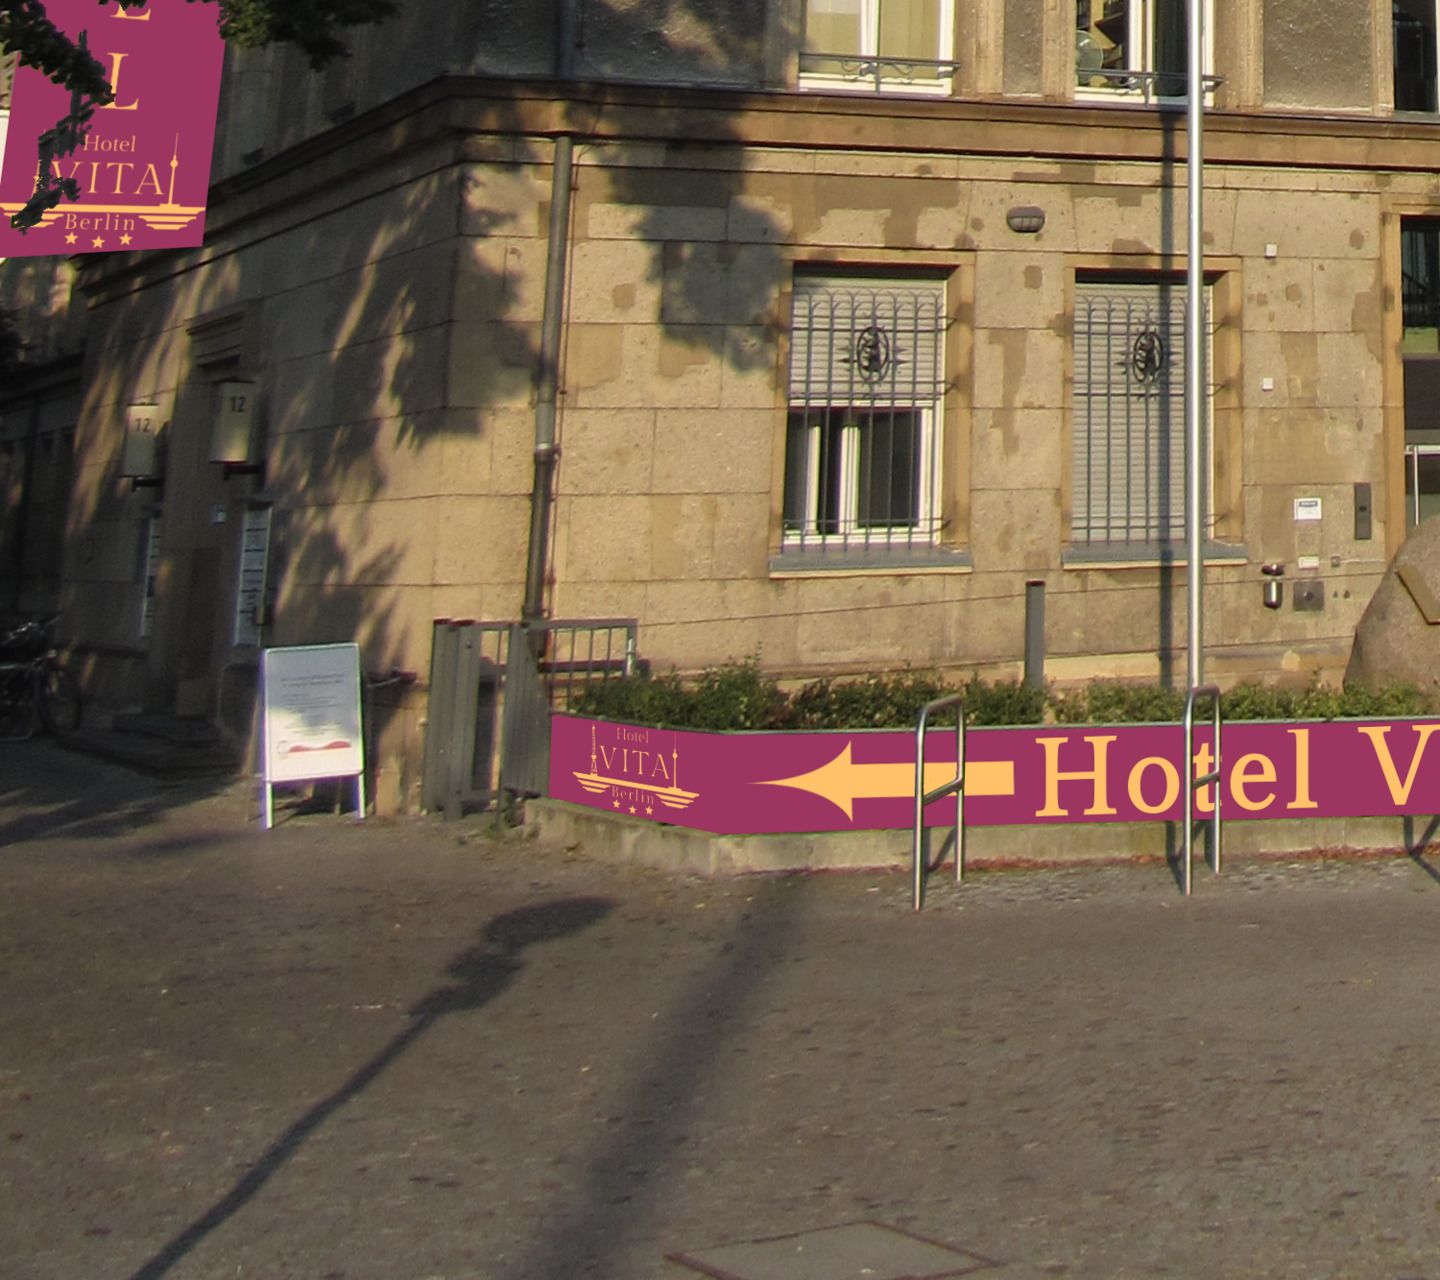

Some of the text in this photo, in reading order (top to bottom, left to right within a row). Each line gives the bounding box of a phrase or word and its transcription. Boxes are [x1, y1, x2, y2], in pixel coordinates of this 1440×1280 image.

[83, 134, 136, 153] Hotel
[52, 160, 165, 195] VITA
[65, 212, 135, 231] Berlin
[230, 396, 246, 413] 12
[135, 417, 151, 433] 12
[616, 727, 649, 744] Hotel
[600, 745, 670, 780] VITA
[1034, 727, 1318, 818] Hotel
[611, 784, 654, 805] Berlin
